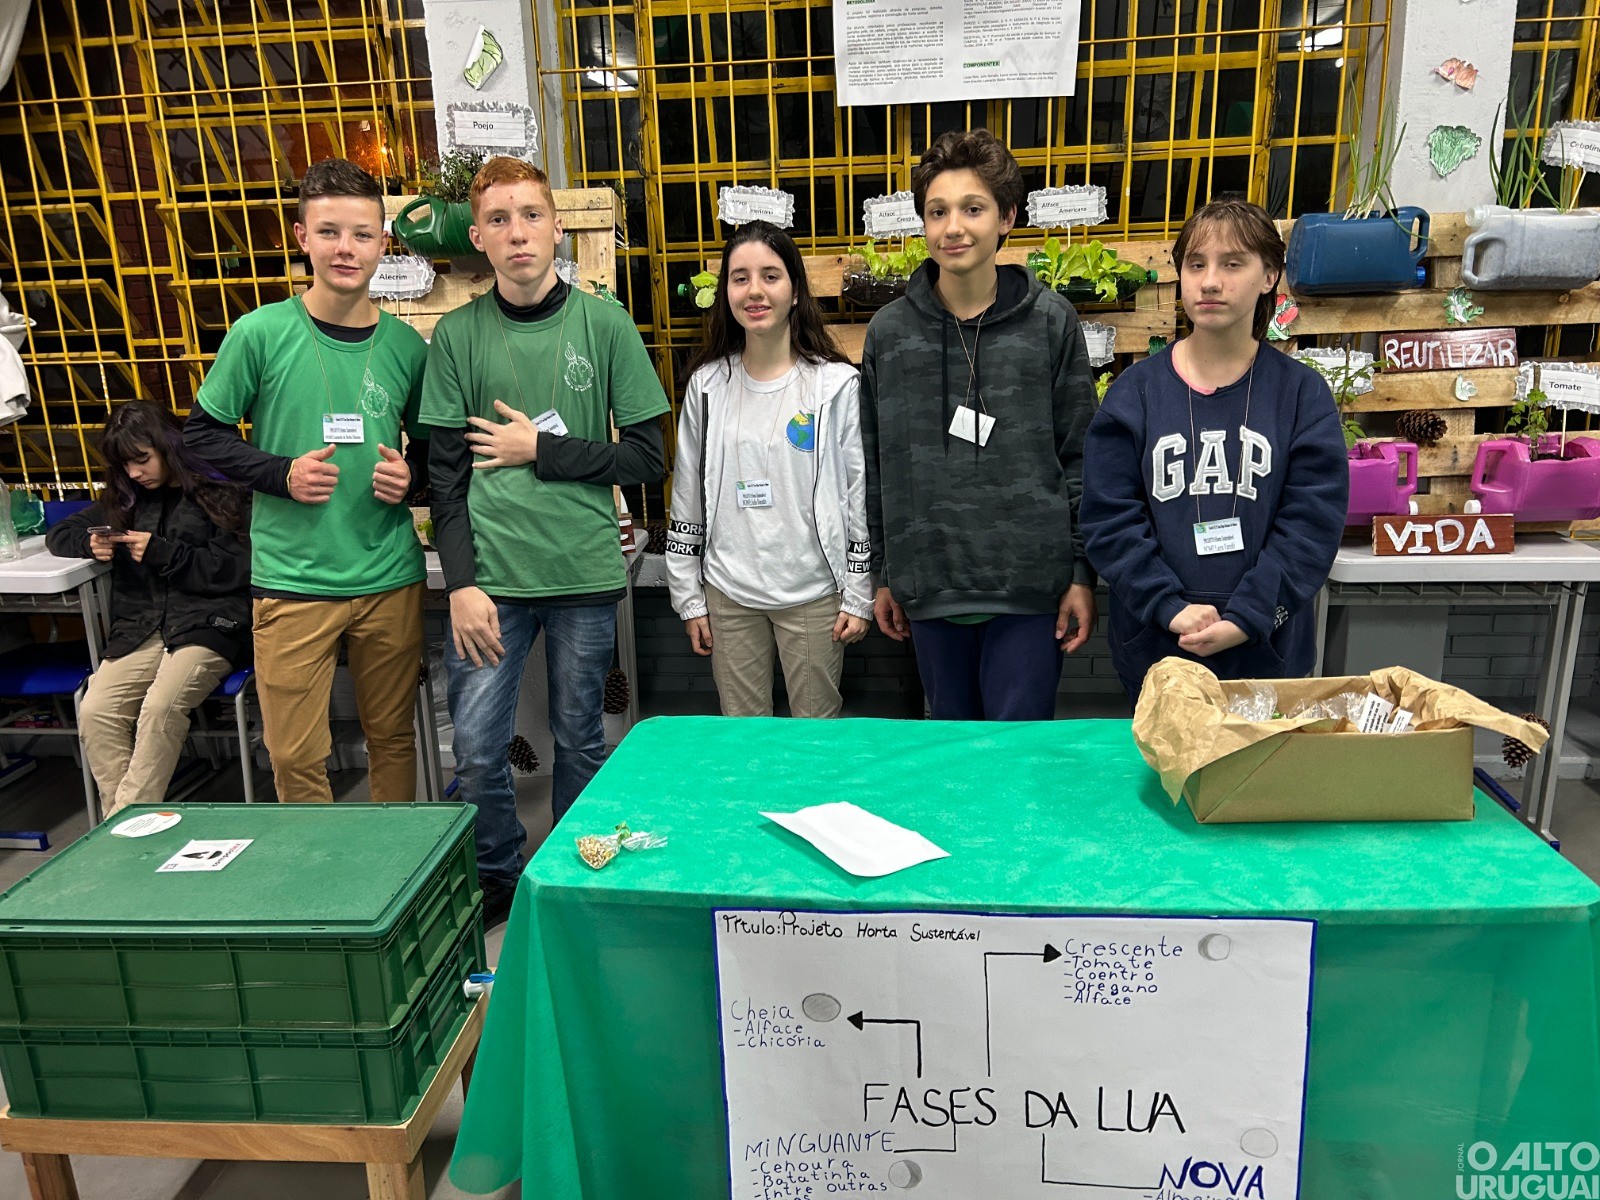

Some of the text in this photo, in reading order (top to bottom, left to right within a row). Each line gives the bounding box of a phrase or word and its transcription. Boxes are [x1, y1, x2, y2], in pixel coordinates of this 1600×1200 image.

[473, 121, 494, 131] Poejo
[1549, 382, 1582, 391] Tomate
[1152, 425, 1271, 502] GAP
[1383, 518, 1495, 554] VIDA
[666, 540, 695, 555] YORK
[857, 922, 898, 938] Horta
[910, 923, 981, 942] Sustentável
[1065, 935, 1183, 957] Crescente
[730, 997, 795, 1021] Cheia
[863, 1083, 1186, 1133] FASES DA LUA
[827, 1179, 888, 1194] outras
[1159, 1155, 1264, 1200] NOVA
